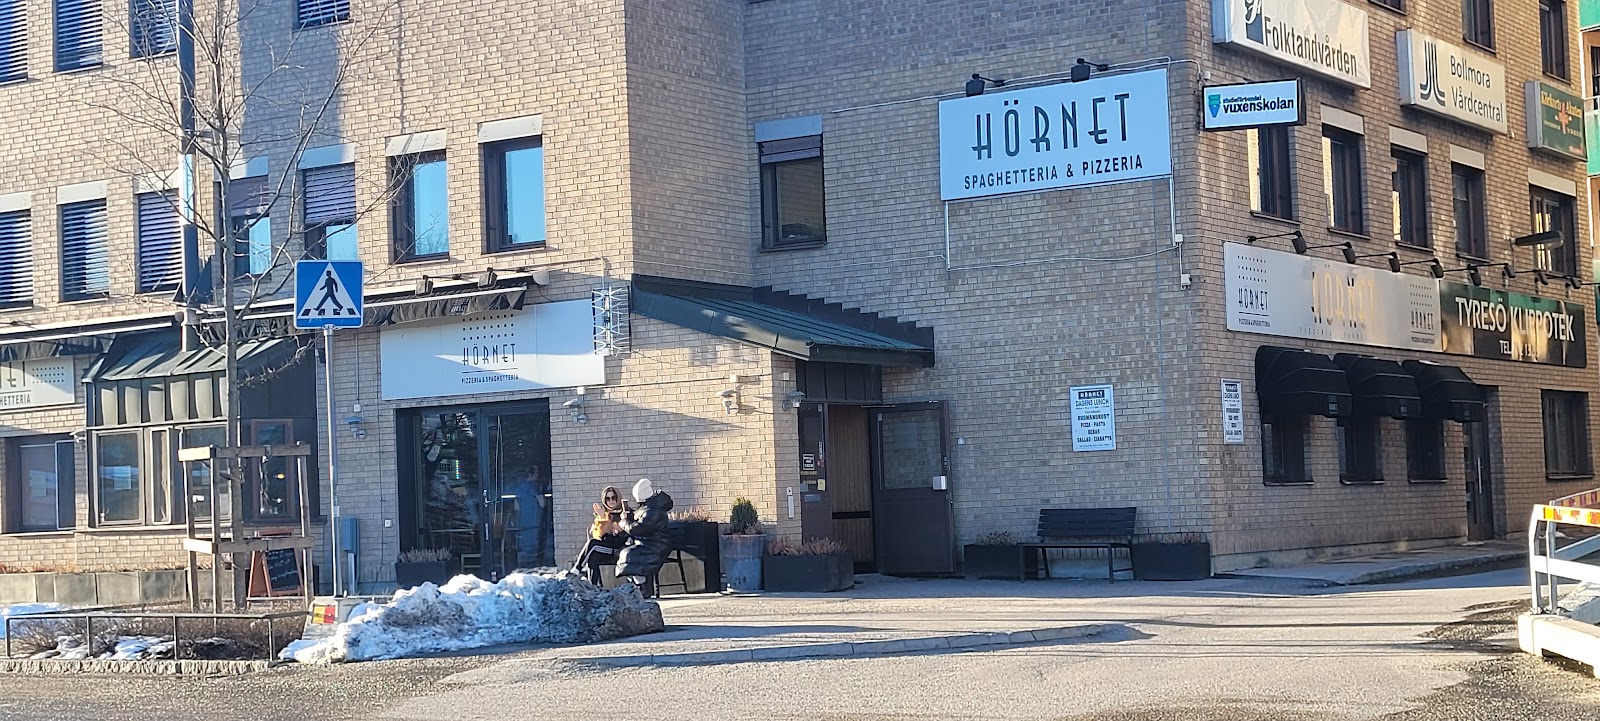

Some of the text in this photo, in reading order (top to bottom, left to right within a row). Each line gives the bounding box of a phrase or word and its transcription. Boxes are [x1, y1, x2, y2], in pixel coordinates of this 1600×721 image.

[1264, 16, 1358, 77] Folktandvården
[1450, 55, 1491, 88] Bollmora
[1223, 97, 1294, 114] vuxenskolan
[1451, 86, 1504, 123] Vårdcentral
[972, 93, 1130, 160] HÖRNET
[964, 154, 1143, 190] SPAGHETTERIA & PIZZERIA
[1238, 285, 1268, 311] HÖRNET
[1455, 297, 1575, 342] TYRESÖ KLIPPOTEK
[462, 343, 516, 367] HÖRNET
